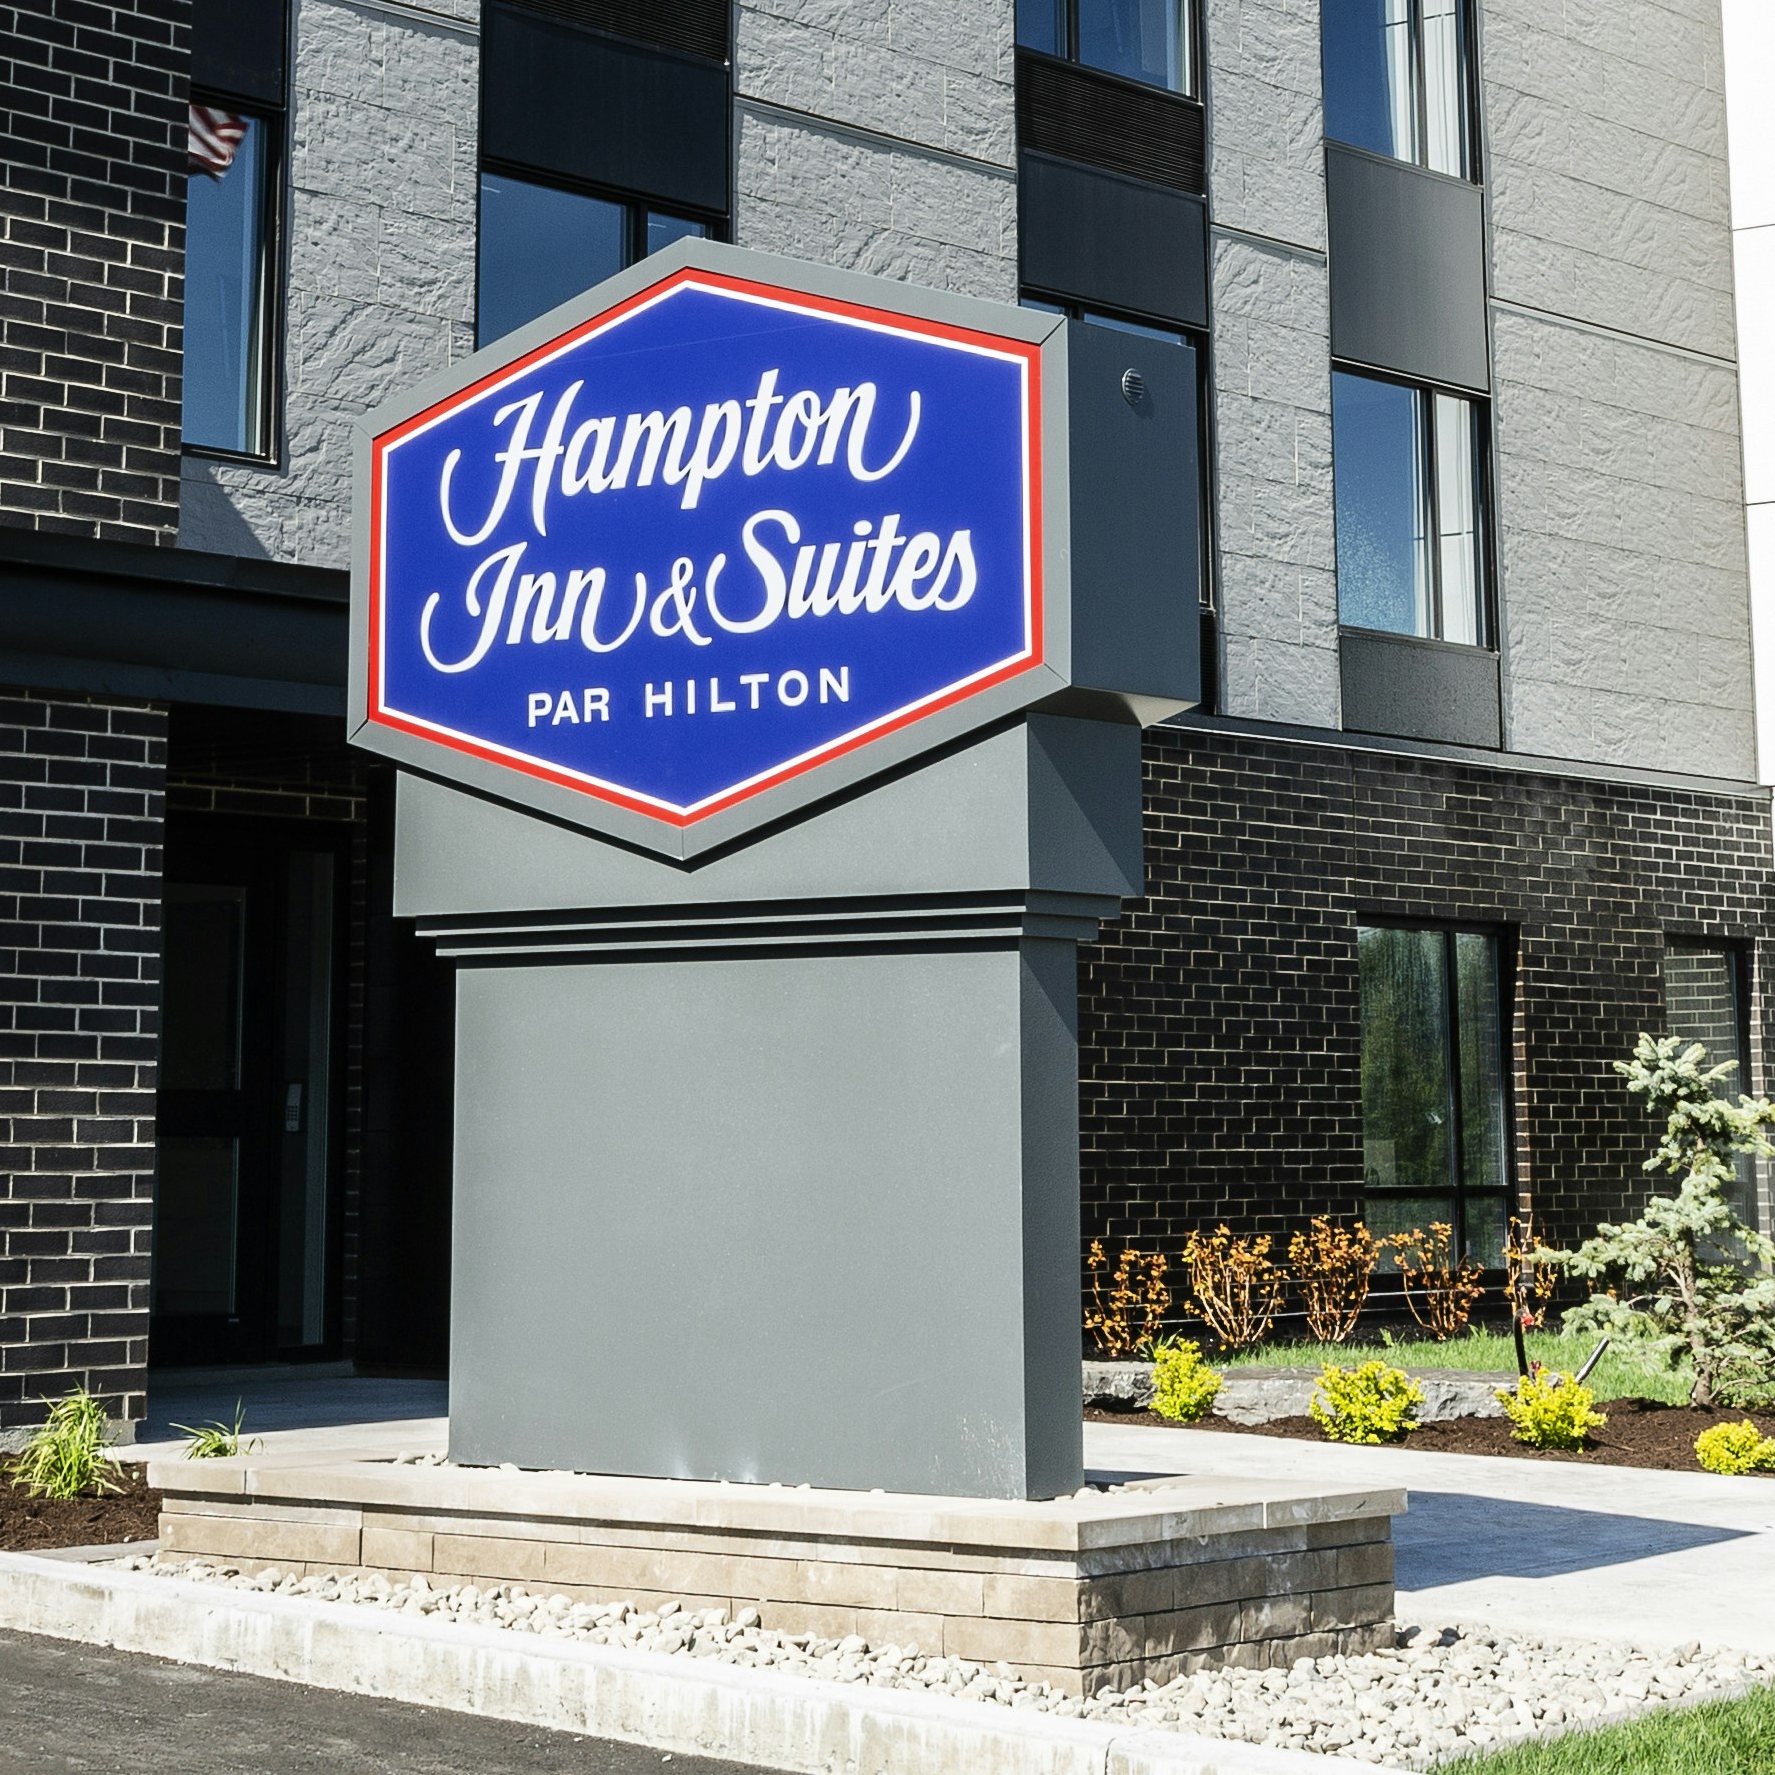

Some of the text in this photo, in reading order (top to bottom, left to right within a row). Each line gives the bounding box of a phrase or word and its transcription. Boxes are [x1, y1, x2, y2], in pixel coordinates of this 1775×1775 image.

[439, 368, 922, 547] Hampton
[419, 509, 978, 674] Inn & Suites
[527, 665, 851, 728] PAR HILTON
